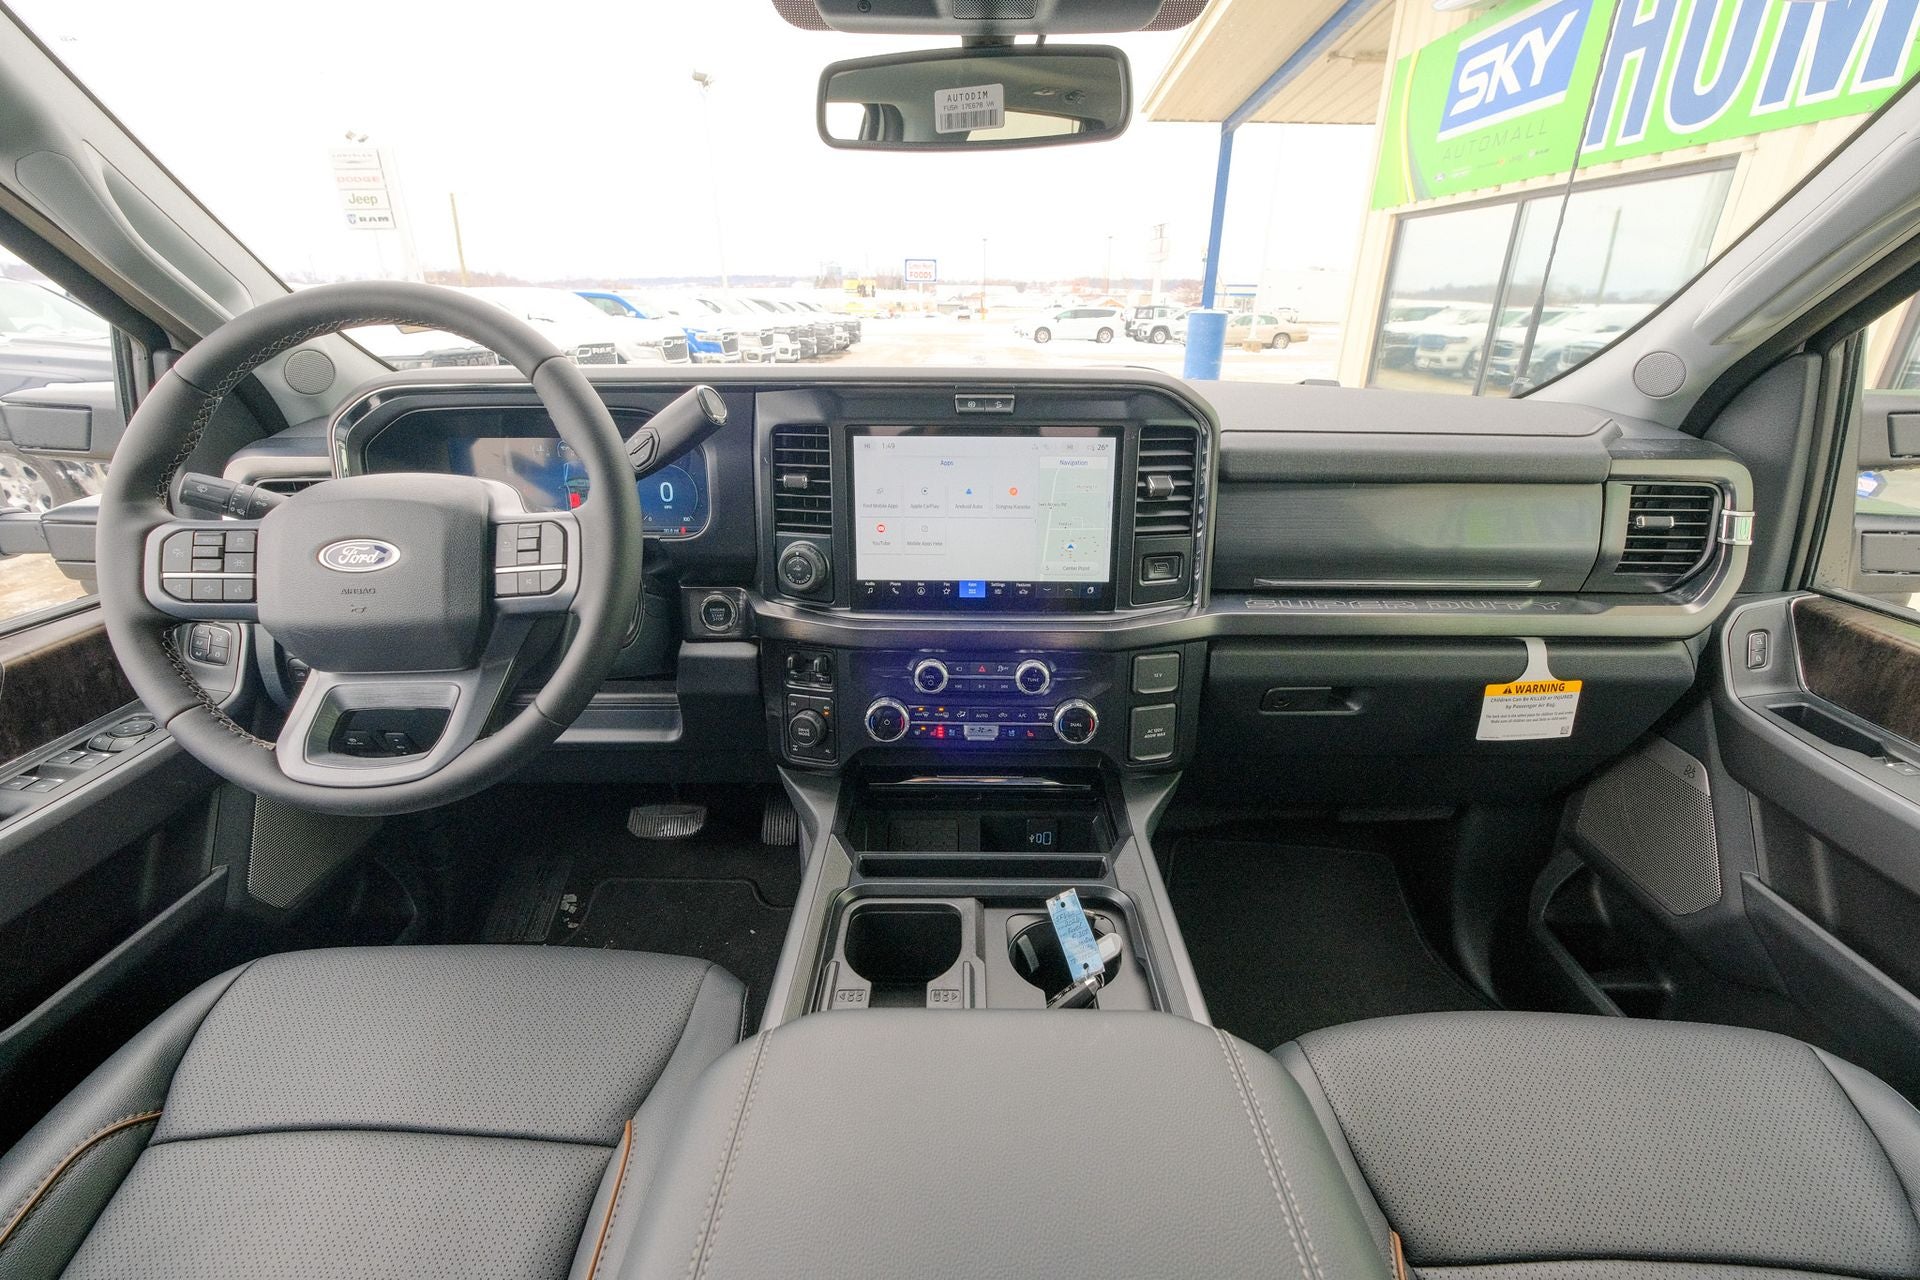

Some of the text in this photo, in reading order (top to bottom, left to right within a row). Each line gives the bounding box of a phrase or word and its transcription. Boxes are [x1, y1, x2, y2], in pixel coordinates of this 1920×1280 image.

[1450, 8, 1580, 117] SKY
[947, 90, 988, 102] AUTODIM
[1443, 119, 1547, 160] AUTOMALL
[348, 193, 378, 206] Jeep
[909, 271, 932, 279] FOODS
[660, 481, 674, 502] 0
[338, 546, 379, 564] Ford
[1426, 600, 1560, 610] DUTY
[1515, 683, 1566, 694] WARNING
